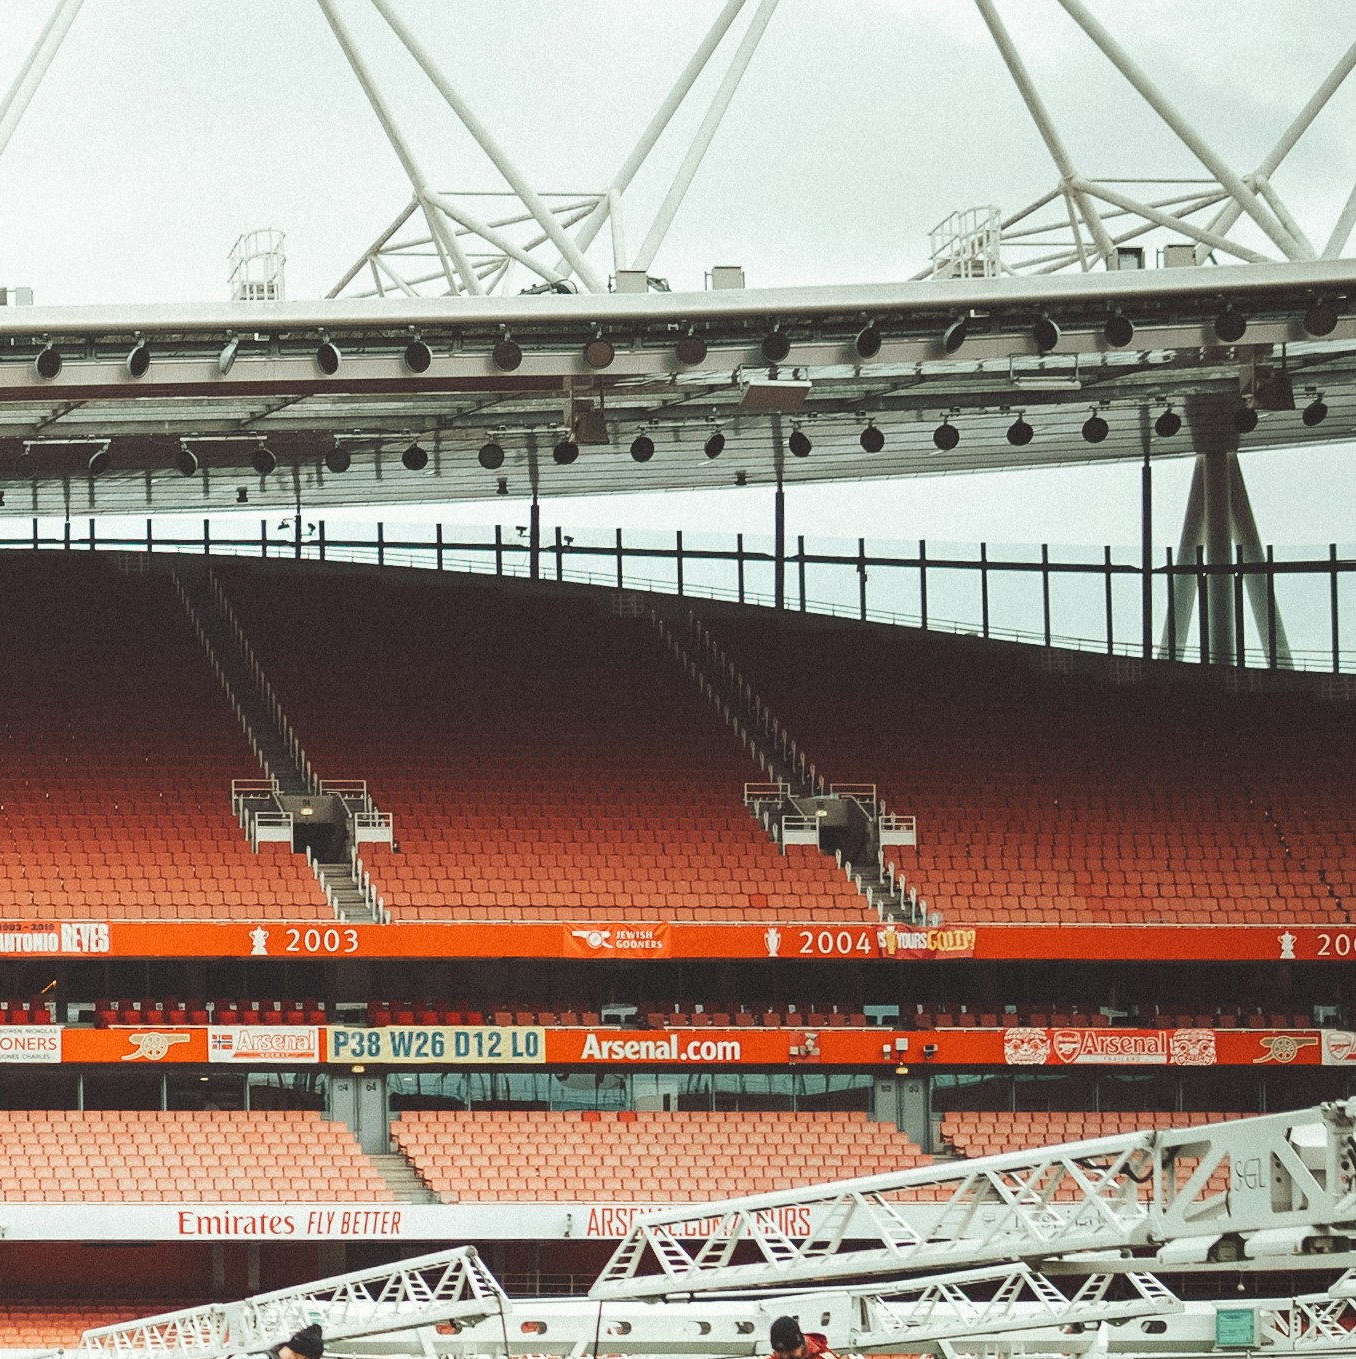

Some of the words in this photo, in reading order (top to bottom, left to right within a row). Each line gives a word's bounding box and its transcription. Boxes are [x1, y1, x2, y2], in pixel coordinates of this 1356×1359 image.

[61, 923, 110, 952] REYES
[285, 929, 359, 953] 2003
[616, 930, 653, 939] JEWISH
[616, 940, 663, 949] GOONERS
[799, 931, 872, 954] 2004
[1317, 933, 1356, 956] 20
[237, 1030, 315, 1050] Arsenal
[333, 1031, 380, 1058] P38
[390, 1031, 445, 1058] W26
[454, 1031, 502, 1058] D12
[581, 1033, 742, 1060] Arsenal.com
[1081, 1031, 1167, 1055] Arsenal
[178, 1210, 295, 1235] Emirates
[307, 1211, 334, 1234] FLY
[341, 1211, 401, 1234] BETTER
